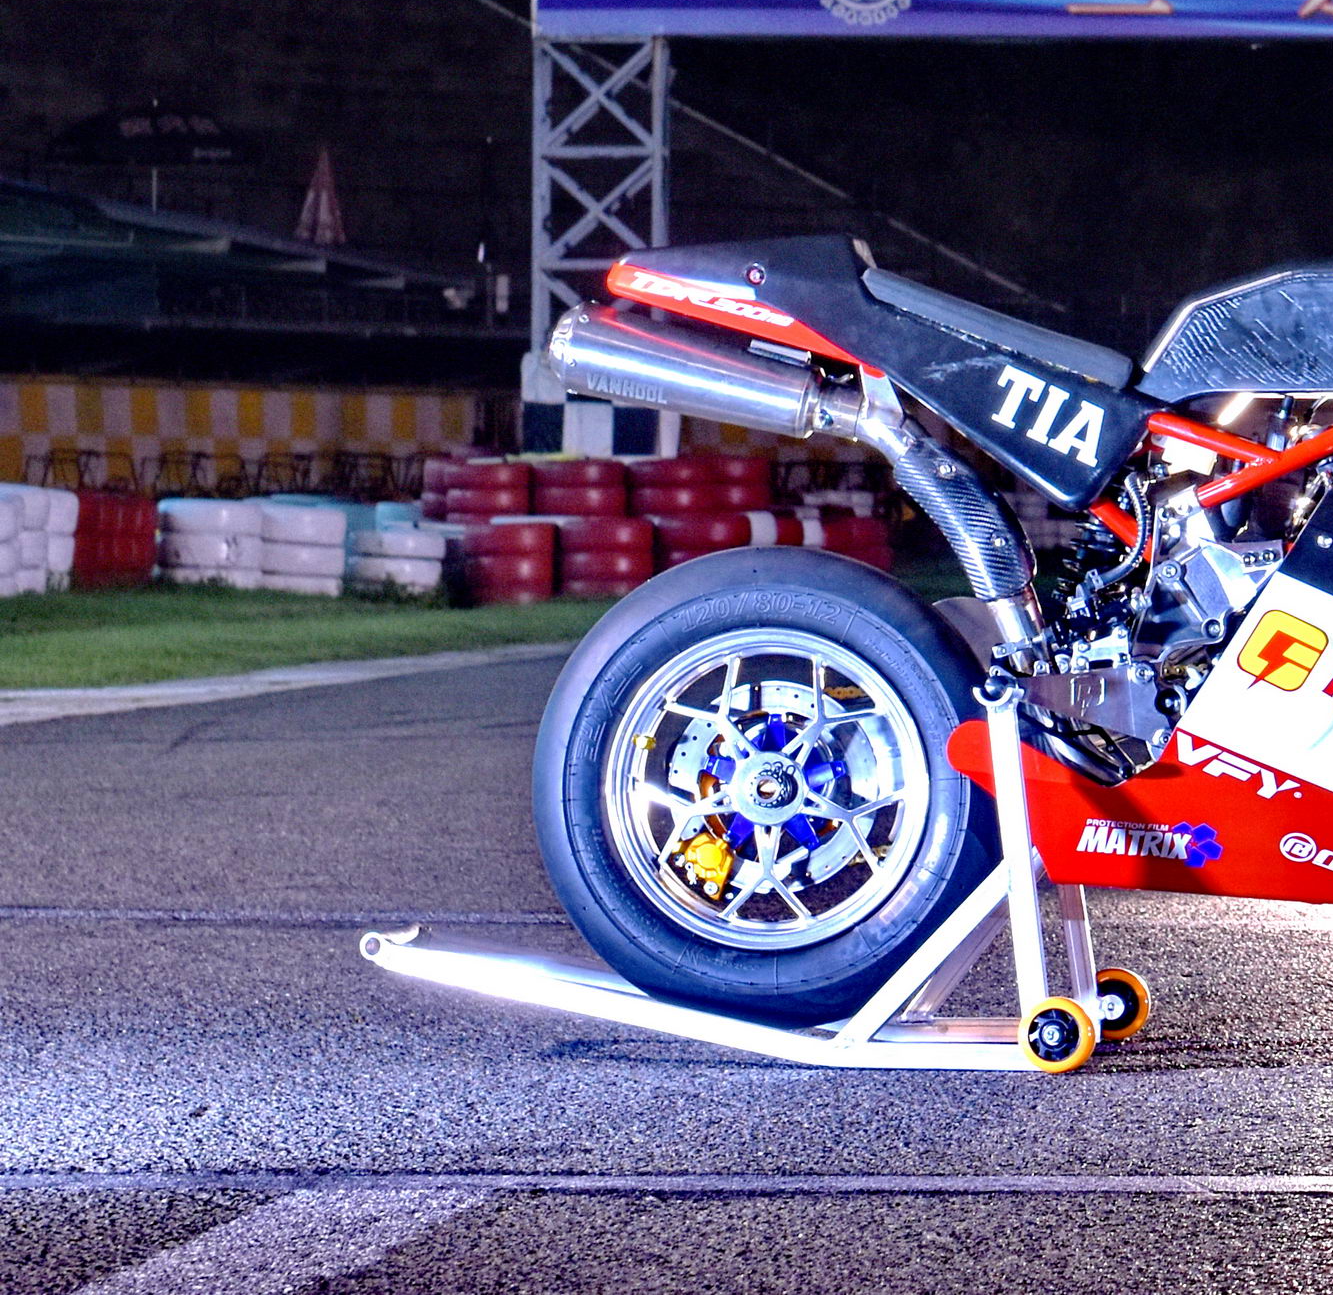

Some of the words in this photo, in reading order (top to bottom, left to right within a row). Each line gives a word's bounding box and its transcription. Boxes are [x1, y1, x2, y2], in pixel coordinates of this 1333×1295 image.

[586, 372, 668, 405] VANHOOL
[990, 364, 1106, 468] TIA
[1086, 818, 1146, 831] PROTECTION
[1147, 823, 1170, 832] FILM
[1076, 826, 1192, 860] MATRIX
